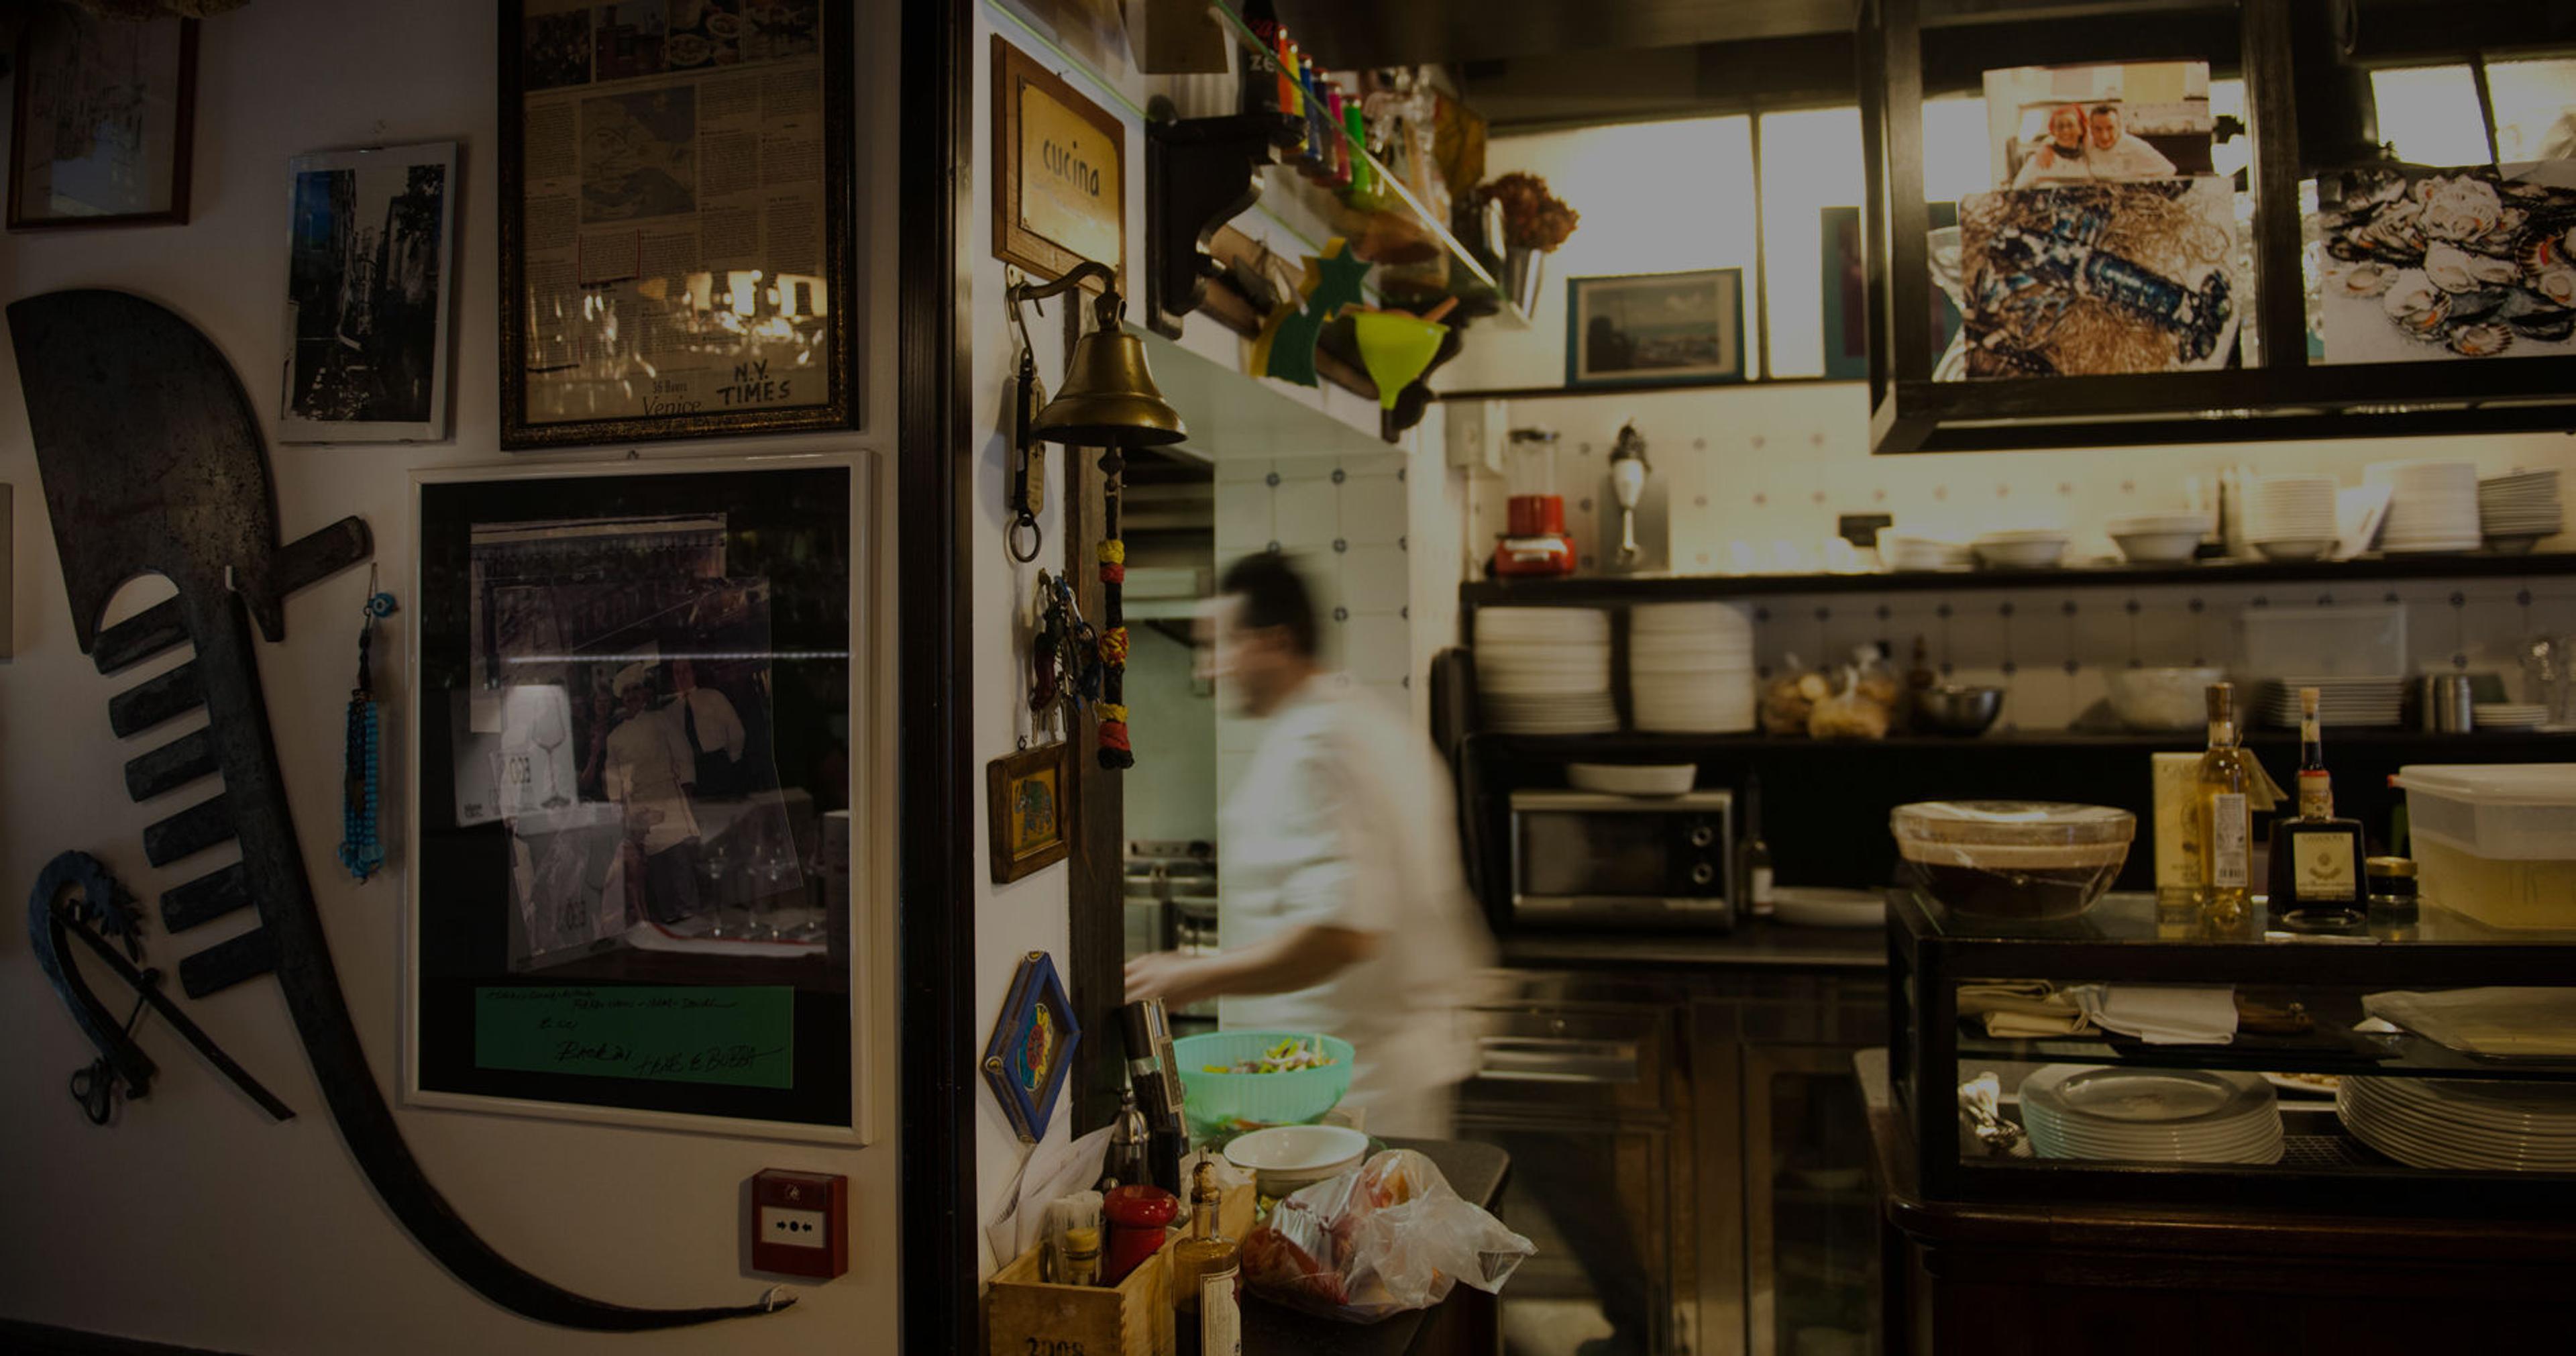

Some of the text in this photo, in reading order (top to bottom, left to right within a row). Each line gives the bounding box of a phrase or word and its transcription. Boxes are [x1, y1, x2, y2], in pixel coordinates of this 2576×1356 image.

[1042, 139, 1099, 197] cucina
[735, 359, 768, 381] N.Y.
[716, 380, 790, 405] TIMES
[643, 396, 702, 415] Venice
